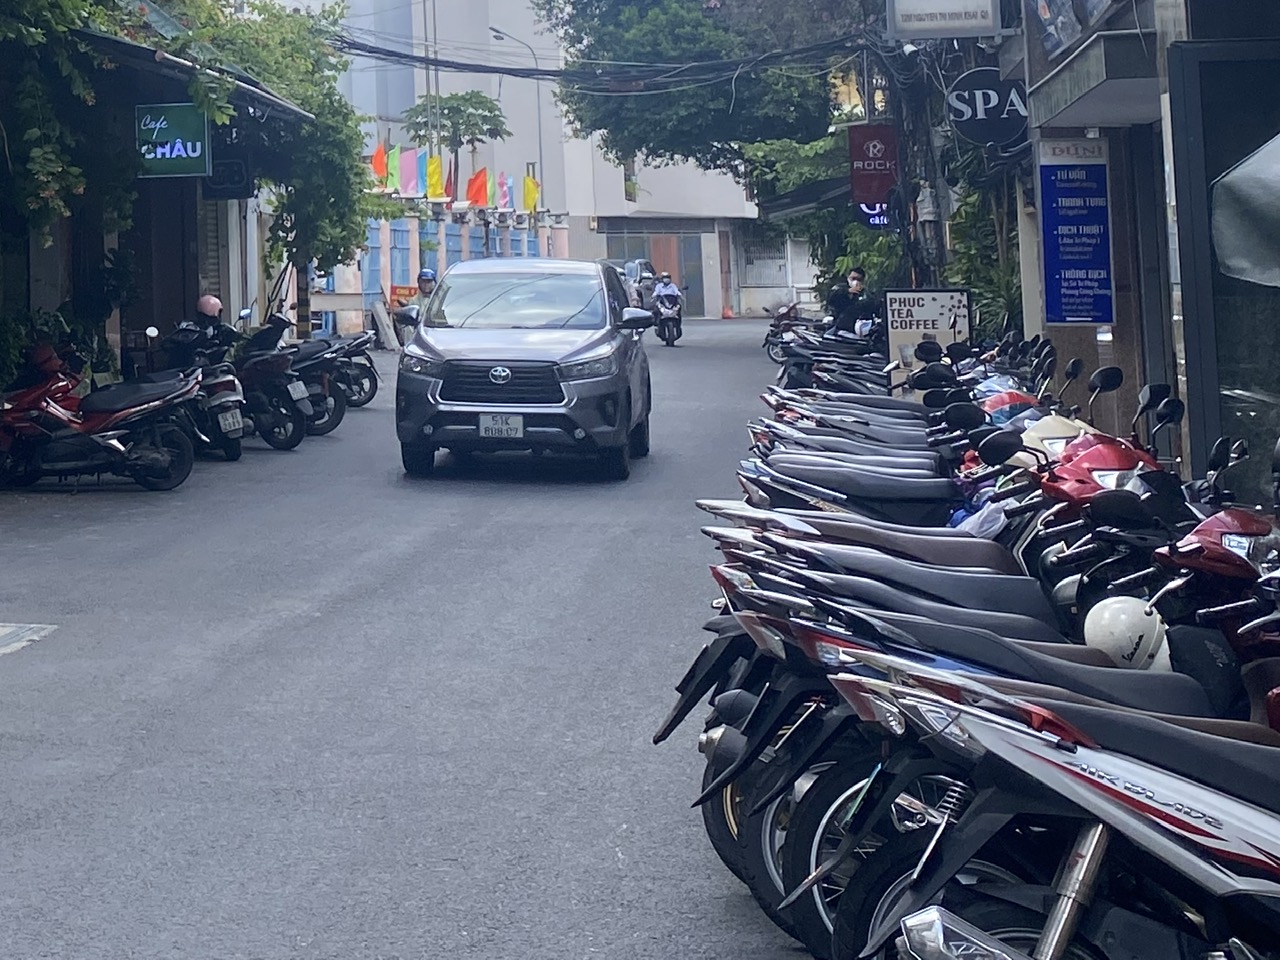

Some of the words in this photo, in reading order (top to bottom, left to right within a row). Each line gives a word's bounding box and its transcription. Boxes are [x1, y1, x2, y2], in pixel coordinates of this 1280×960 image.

[948, 87, 1029, 122] SPA
[141, 114, 169, 140] Cafe
[853, 160, 896, 170] ROCK
[889, 297, 925, 308] PHUC
[889, 308, 914, 319] TEA
[890, 319, 940, 330] COFFEE
[491, 415, 511, 427] 51K
